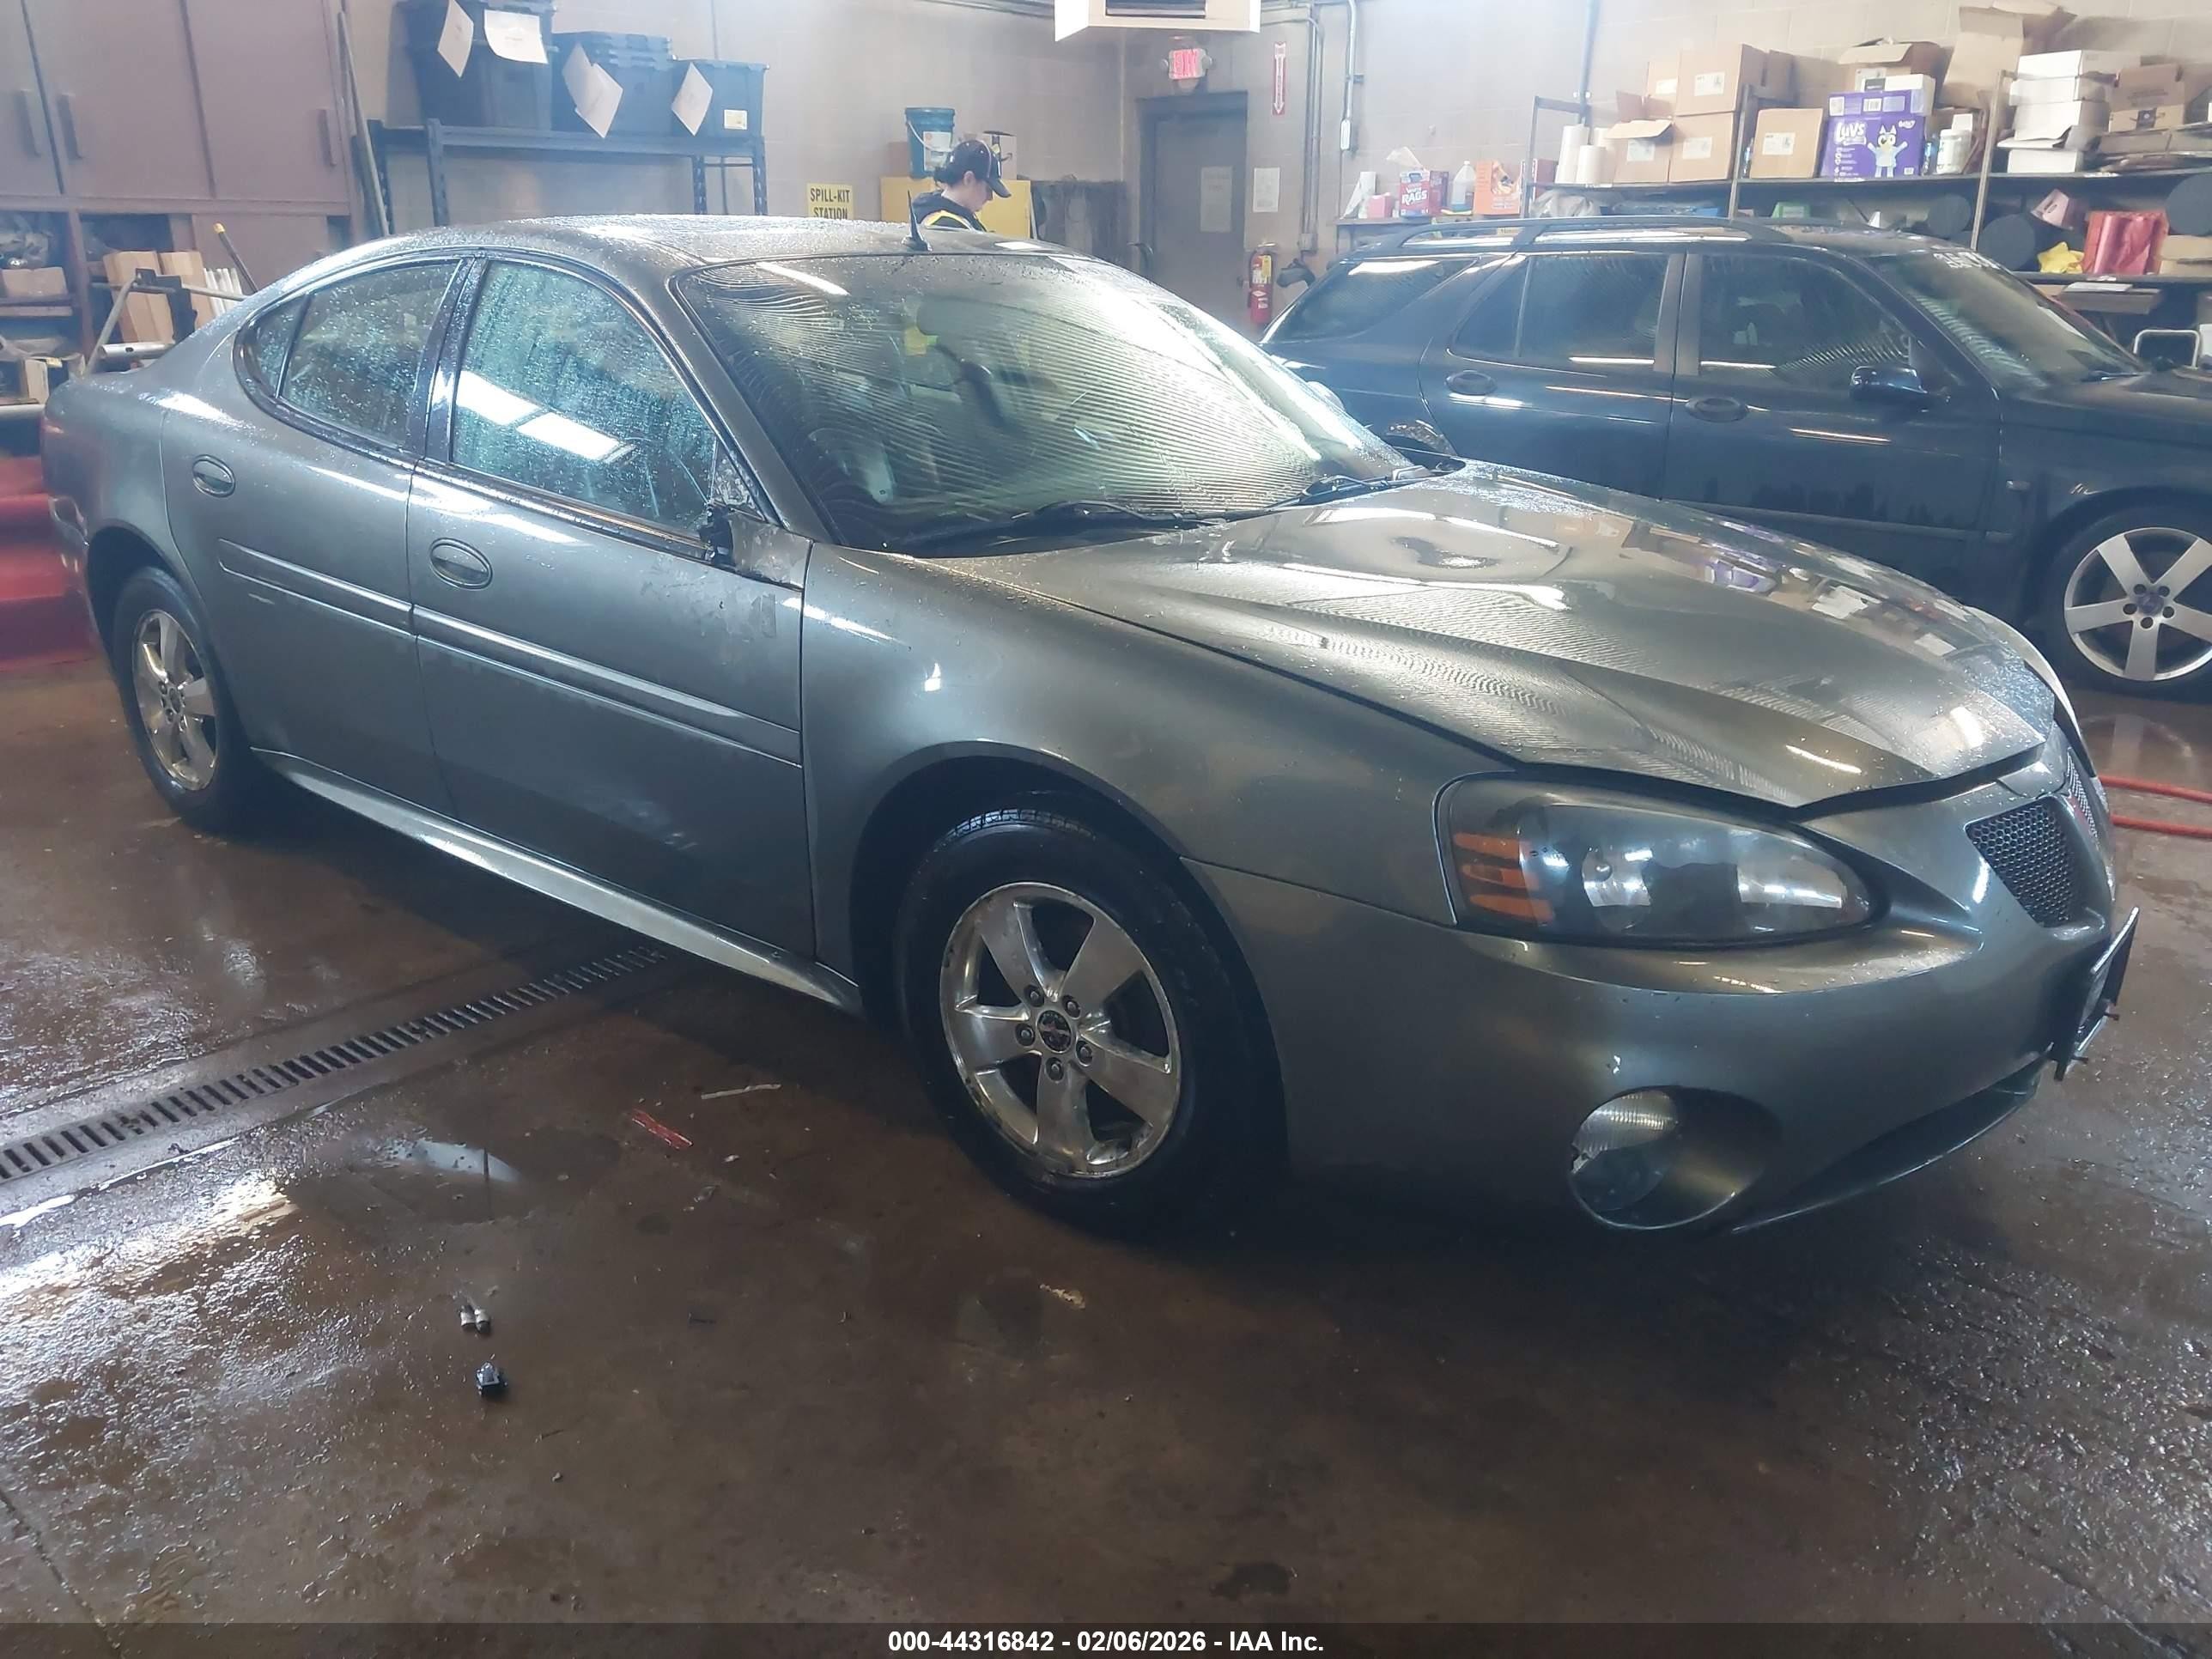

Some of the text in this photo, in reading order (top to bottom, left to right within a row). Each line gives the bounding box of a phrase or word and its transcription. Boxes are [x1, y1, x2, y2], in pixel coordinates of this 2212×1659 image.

[810, 188, 850, 203] SPILL-KIT
[1401, 190, 1427, 205] RAGS
[813, 207, 848, 219] STATION
